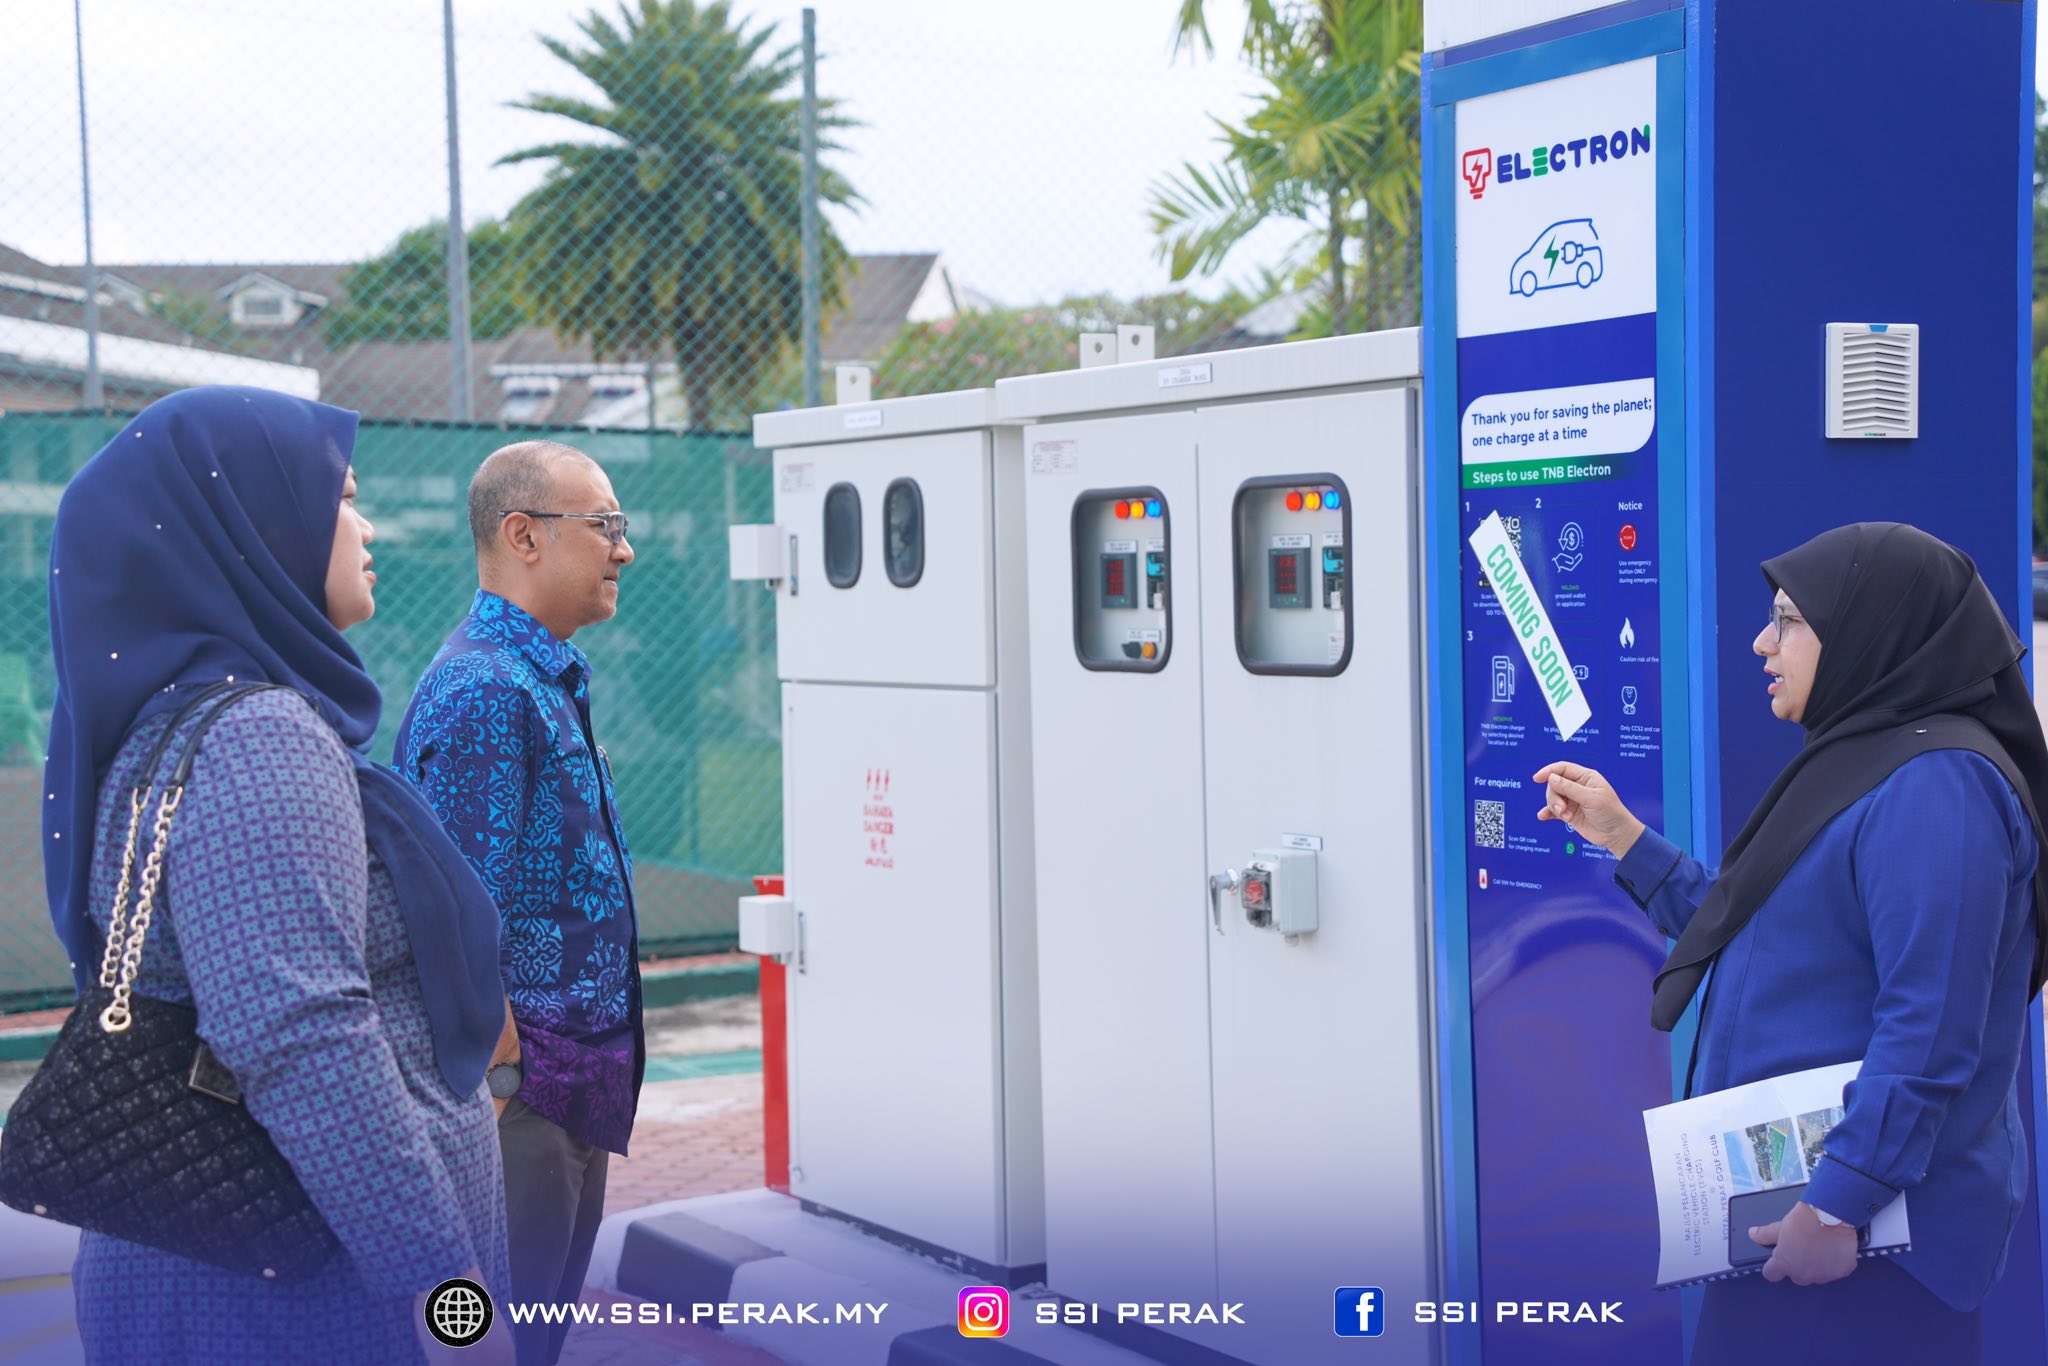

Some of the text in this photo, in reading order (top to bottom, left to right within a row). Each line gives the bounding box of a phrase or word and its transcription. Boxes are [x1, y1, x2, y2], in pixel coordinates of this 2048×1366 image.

[1497, 124, 1650, 183] ELECTRON
[1472, 411, 1507, 426] Thank
[1510, 409, 1530, 425] you
[1533, 407, 1549, 420] for
[1552, 404, 1589, 419] saving
[1592, 401, 1610, 414] the
[1472, 426, 1588, 446] one charge at a time
[1472, 464, 1611, 485] Steps to use TNB Electron
[1465, 501, 1470, 512] 1
[1535, 498, 1542, 508] 2
[1618, 501, 1643, 511] Notice
[1487, 544, 1540, 639] COMING
[1467, 631, 1473, 641] 3
[1531, 635, 1573, 708] SOON
[1620, 725, 1630, 733] Only
[1640, 743, 1660, 751] adaptors
[1474, 776, 1521, 789] For enquiries
[1515, 844, 1534, 853] charging
[1516, 881, 1543, 890] EMERGENCY
[1709, 1134, 1718, 1157] CLUB
[1714, 1156, 1724, 1182] GOLF
[1674, 1151, 1689, 1210] PELANCARAN
[1680, 1132, 1701, 1256] ELECTRIC VEHICLE CHARGING
[1718, 1184, 1728, 1211] PERAK
[1700, 1189, 1710, 1226] STATION
